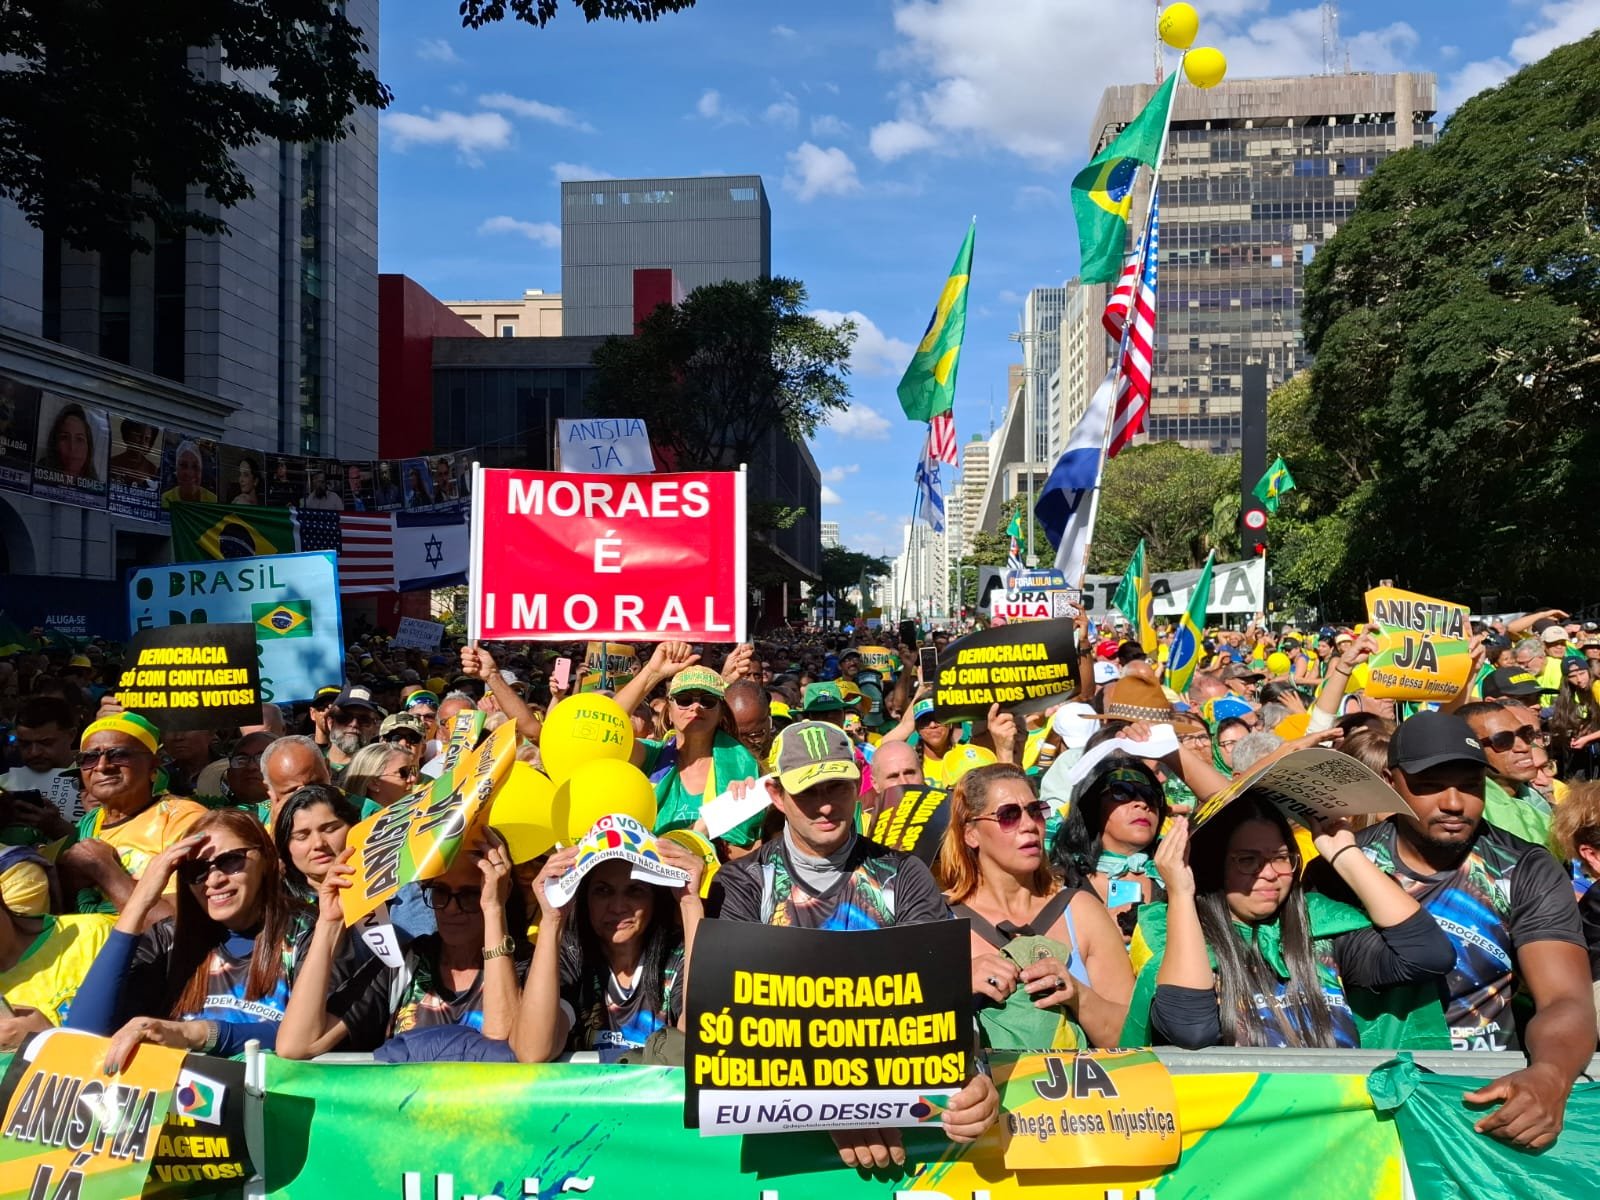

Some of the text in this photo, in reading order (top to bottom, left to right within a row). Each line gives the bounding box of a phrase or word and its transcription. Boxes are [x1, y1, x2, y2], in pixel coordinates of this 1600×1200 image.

[568, 418, 644, 443] ANISTIA
[588, 440, 624, 470] JÁ
[507, 478, 710, 518] MORAES
[593, 529, 622, 574] É
[136, 564, 286, 600] O BRASIL
[1005, 591, 1050, 603] ORA
[45, 615, 87, 625] ALUGA-SE
[484, 592, 731, 633] IMORAL
[994, 604, 1050, 617] LULA
[1374, 598, 1464, 640] ANISTIA
[136, 646, 229, 666] DEMOCRACIA
[589, 652, 633, 673] ANSTIA
[957, 643, 1048, 665] DEMOCRACIA
[1393, 633, 1438, 674] JÁ
[119, 667, 248, 687] SÓ COM CONTAGEM
[940, 663, 1069, 687] SÓ COM CONTAGEM
[1372, 670, 1398, 687] Chega
[1400, 674, 1423, 690] dessa
[170, 691, 200, 708] DOS
[201, 689, 255, 707] VOTOS!
[937, 686, 991, 706] PÚBLICA
[995, 687, 1024, 703] DOS
[1028, 679, 1075, 699] VOTOS!
[575, 709, 625, 729] JUSTIÇA
[602, 729, 624, 746] JÁ!
[581, 850, 625, 872] VERGONHA
[626, 851, 638, 863] EU
[638, 856, 654, 870] NÃO
[1441, 919, 1506, 960] PROGRESSO
[733, 970, 924, 1009] DEMOCRACIA
[699, 1007, 957, 1048] SÓ COM CONTAGEM
[694, 1050, 966, 1087] PÚBLICA DOS VOTOS!
[4, 1070, 158, 1161] ANISTIA
[716, 1104, 751, 1125] EU
[757, 1098, 813, 1123] NÃO
[1008, 1107, 1175, 1142] Chega dessa Injustiça
[155, 1162, 245, 1183] VOTOS!
